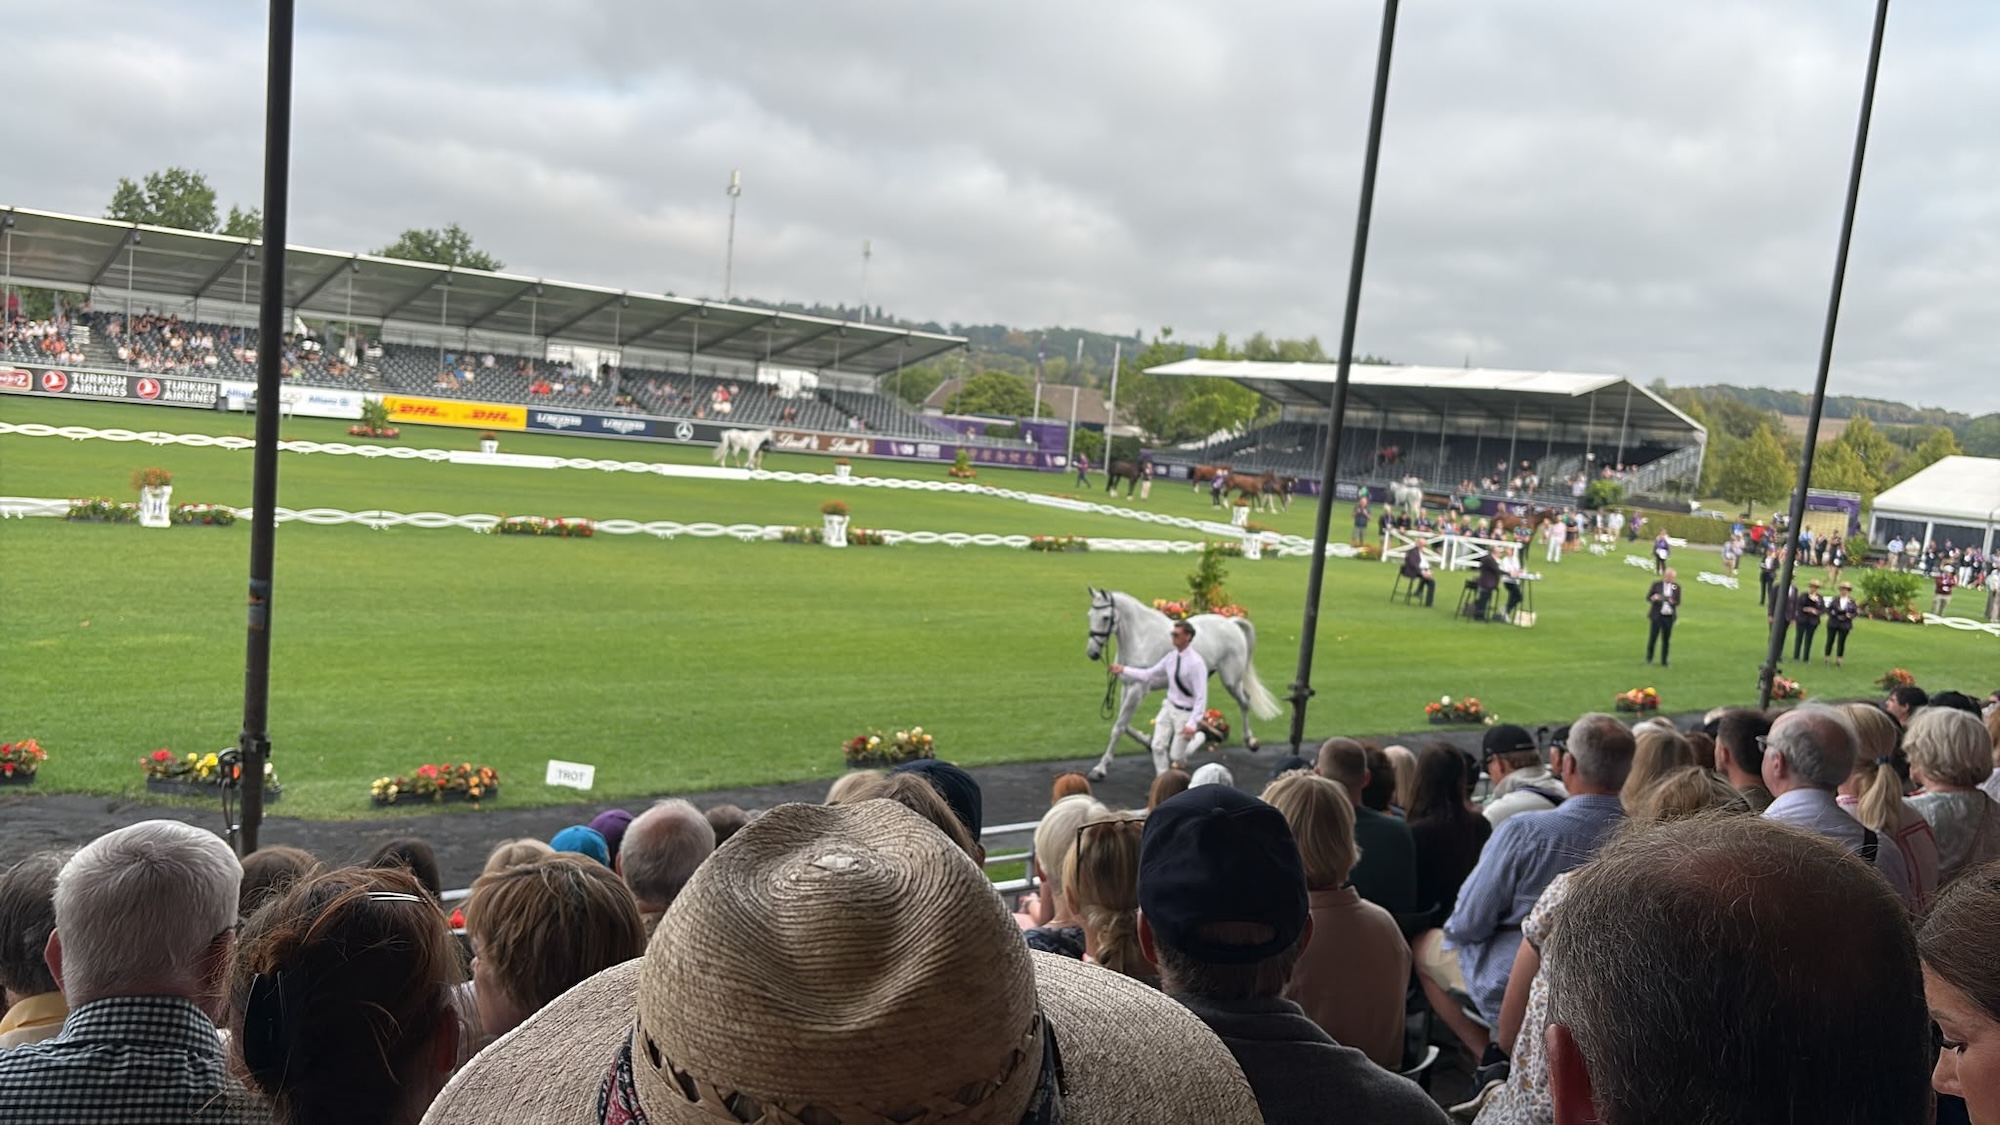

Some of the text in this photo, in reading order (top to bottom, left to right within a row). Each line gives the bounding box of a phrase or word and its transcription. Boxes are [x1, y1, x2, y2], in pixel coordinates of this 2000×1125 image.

[71, 373, 127, 385] TURKISH
[70, 384, 127, 397] AIRLINES
[164, 380, 217, 393] TURKISH
[163, 391, 217, 404] AIRLINES
[400, 403, 437, 416] DHL
[471, 409, 508, 421] DHL
[557, 769, 586, 782] TROT
